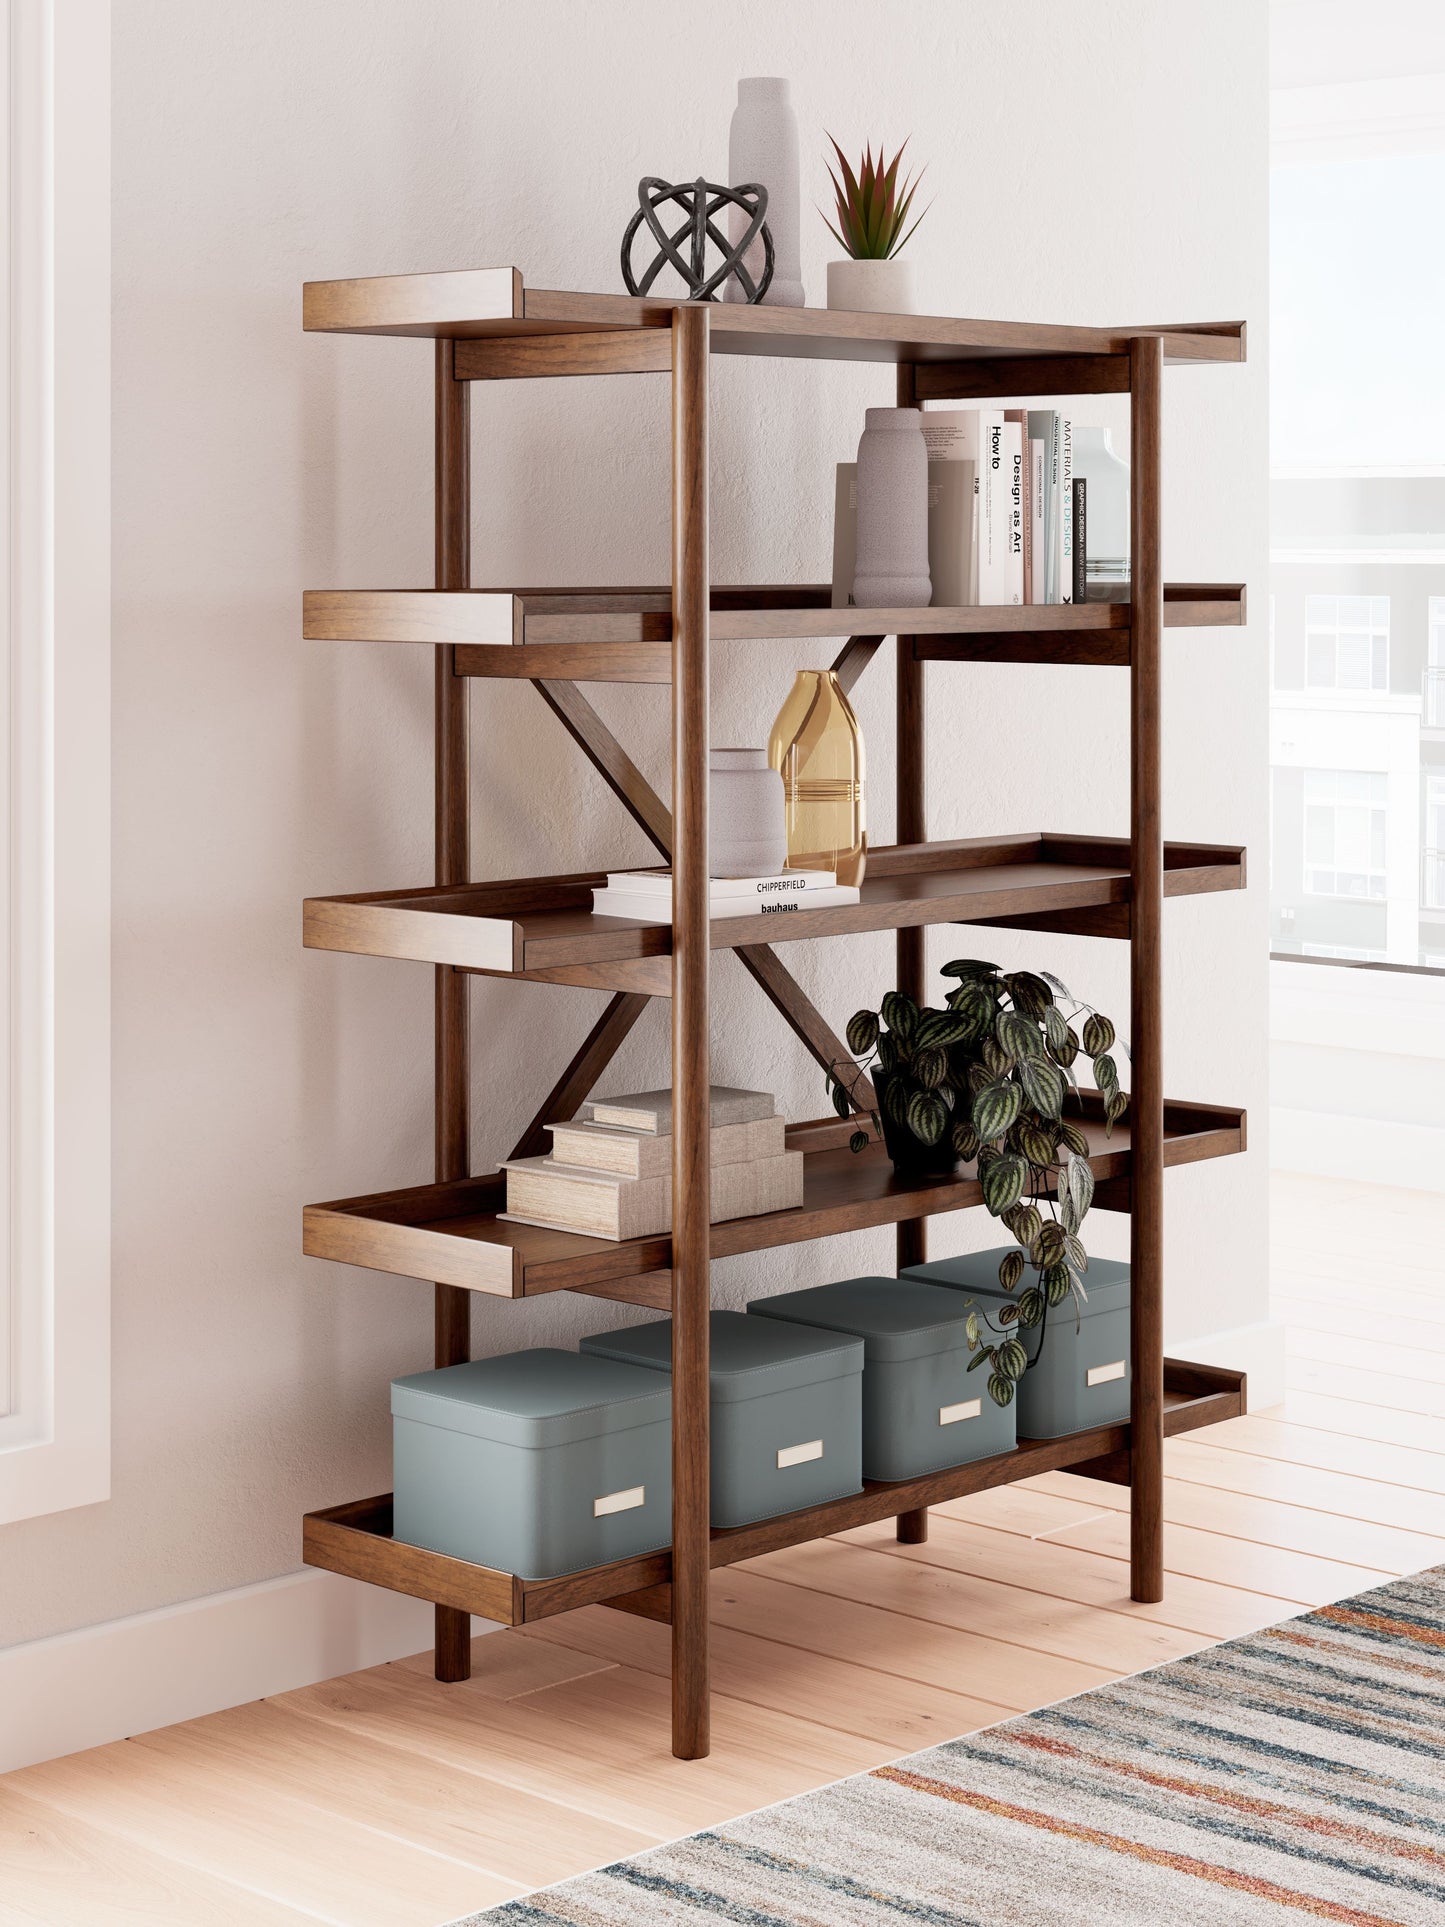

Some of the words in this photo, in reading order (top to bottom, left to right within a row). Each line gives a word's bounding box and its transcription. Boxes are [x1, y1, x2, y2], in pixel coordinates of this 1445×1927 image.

[992, 426, 1001, 454] How
[992, 457, 1001, 469] to
[1064, 420, 1072, 492] MATERIALS
[1011, 455, 1022, 505] Design
[1064, 495, 1072, 504] &
[1013, 510, 1021, 527] as
[1064, 508, 1072, 556] DESIGN
[1013, 532, 1022, 553] Art
[756, 879, 806, 893] CHIPPERFIELD
[761, 902, 798, 914] bauhaus
